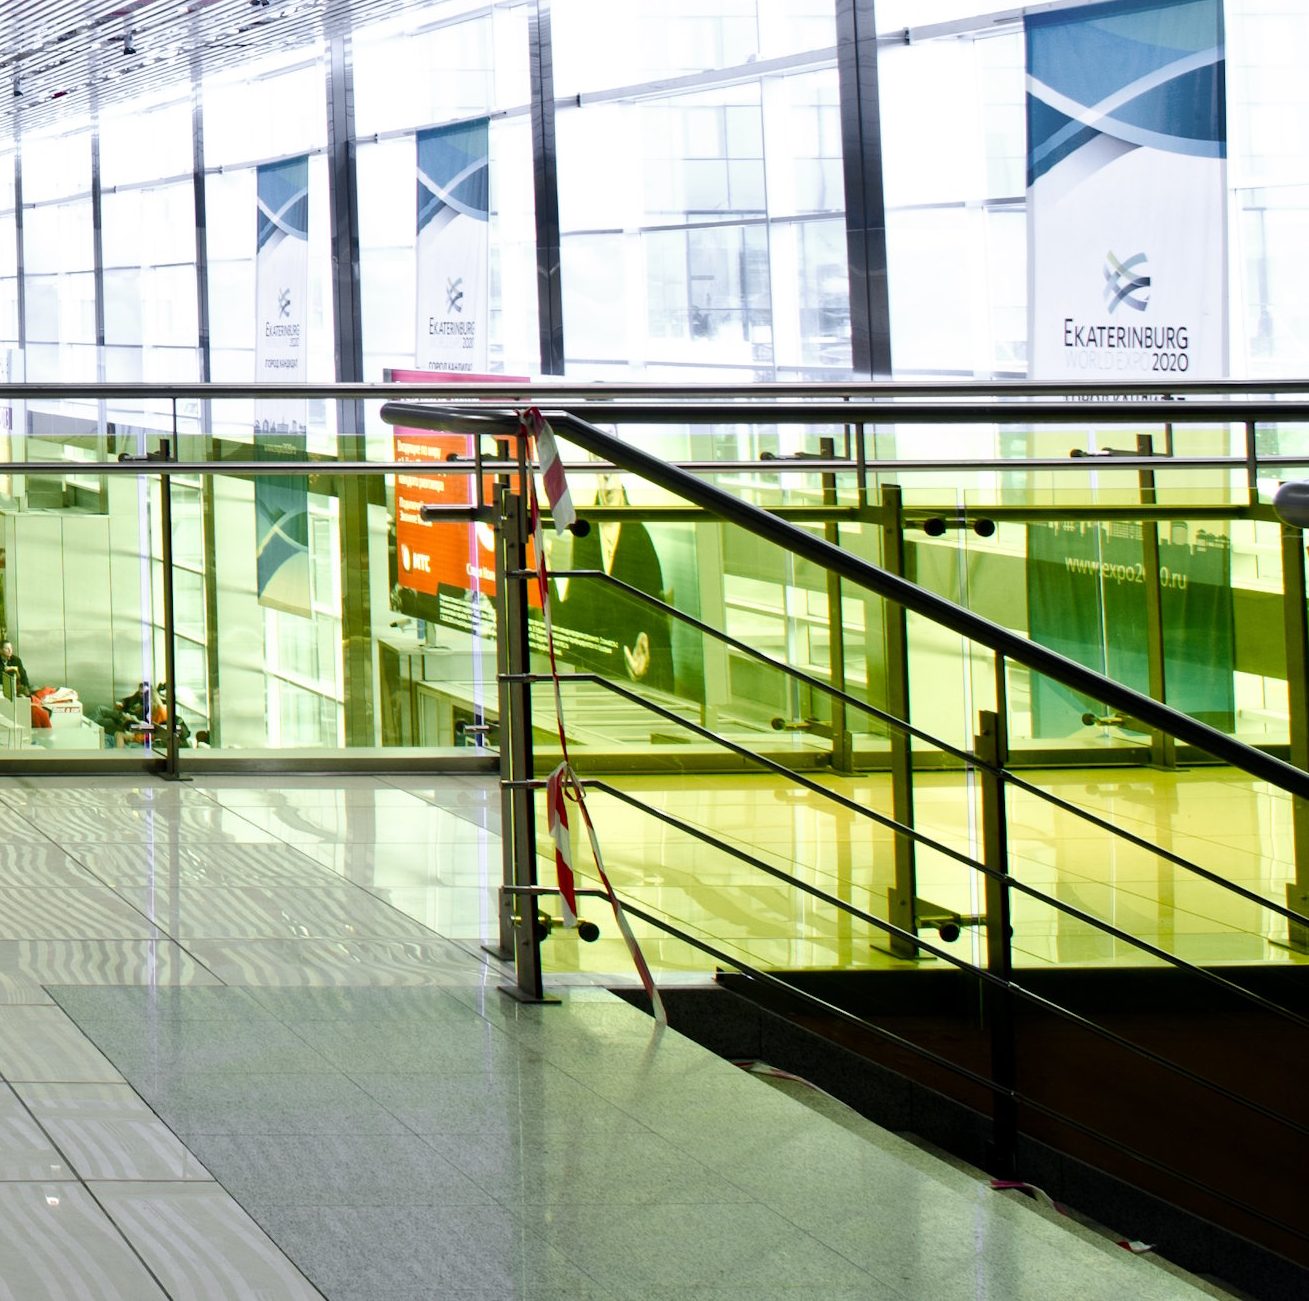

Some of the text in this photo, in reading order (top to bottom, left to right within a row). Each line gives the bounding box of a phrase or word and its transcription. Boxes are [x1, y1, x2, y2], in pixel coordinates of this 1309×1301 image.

[1064, 318, 1189, 350] EKATERINBURG
[1152, 352, 1189, 372] 2020
[1065, 557, 1189, 590] www.expo20.ru
